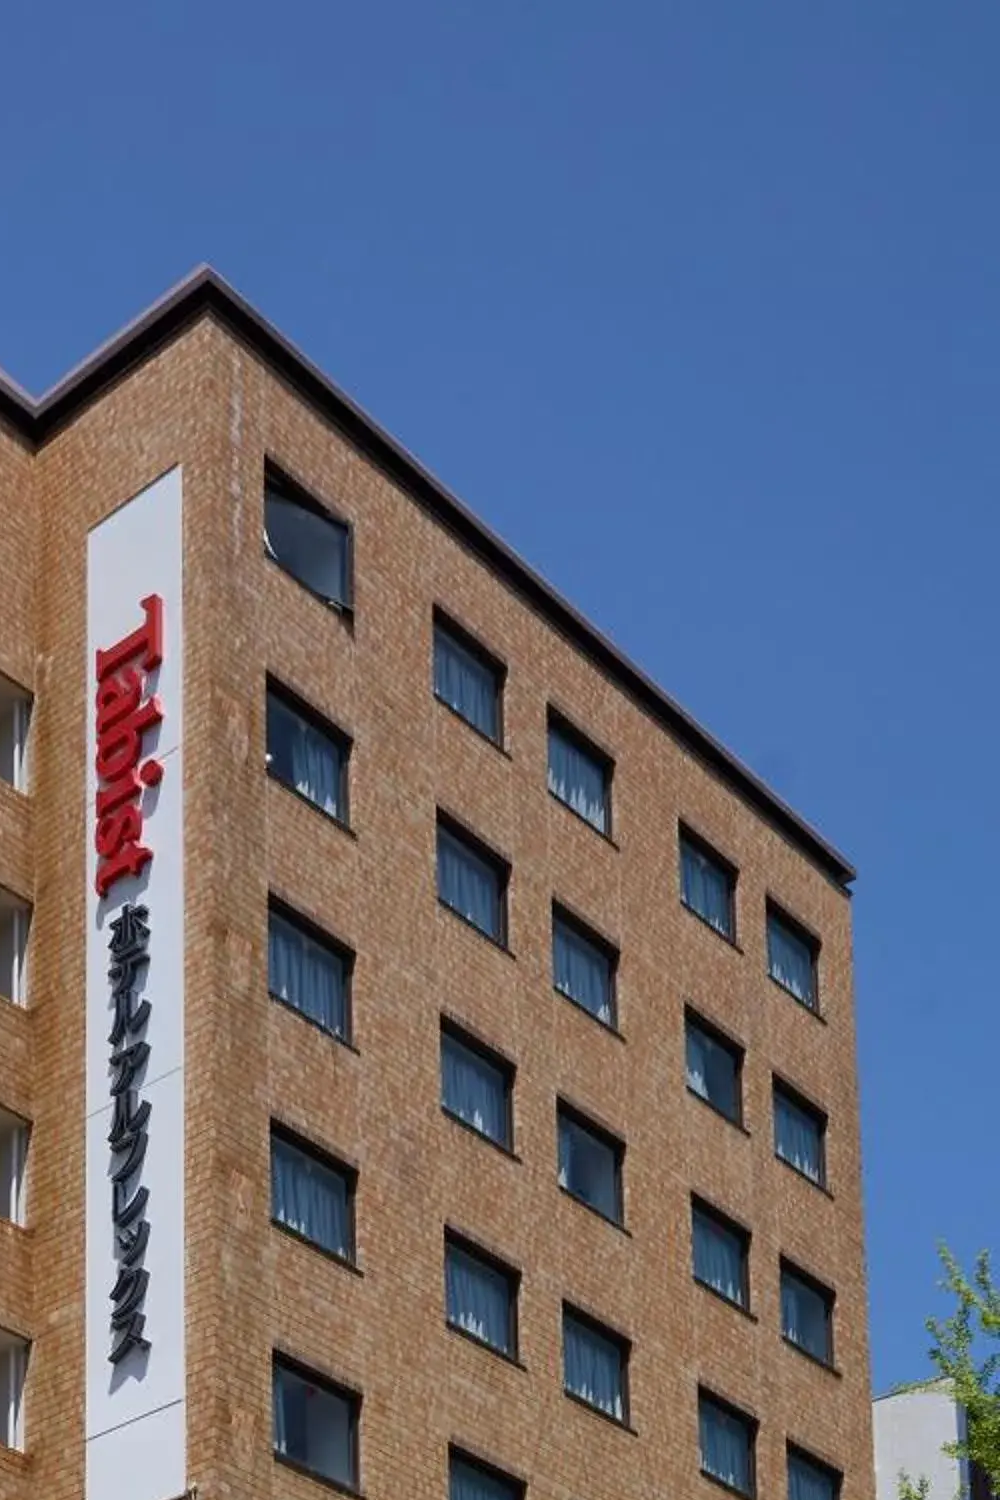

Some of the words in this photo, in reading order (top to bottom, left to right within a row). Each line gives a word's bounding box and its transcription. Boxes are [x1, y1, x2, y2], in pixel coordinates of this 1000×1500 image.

[96, 593, 163, 897] Tabist
[107, 903, 152, 1364] ホテルアルフレックス
